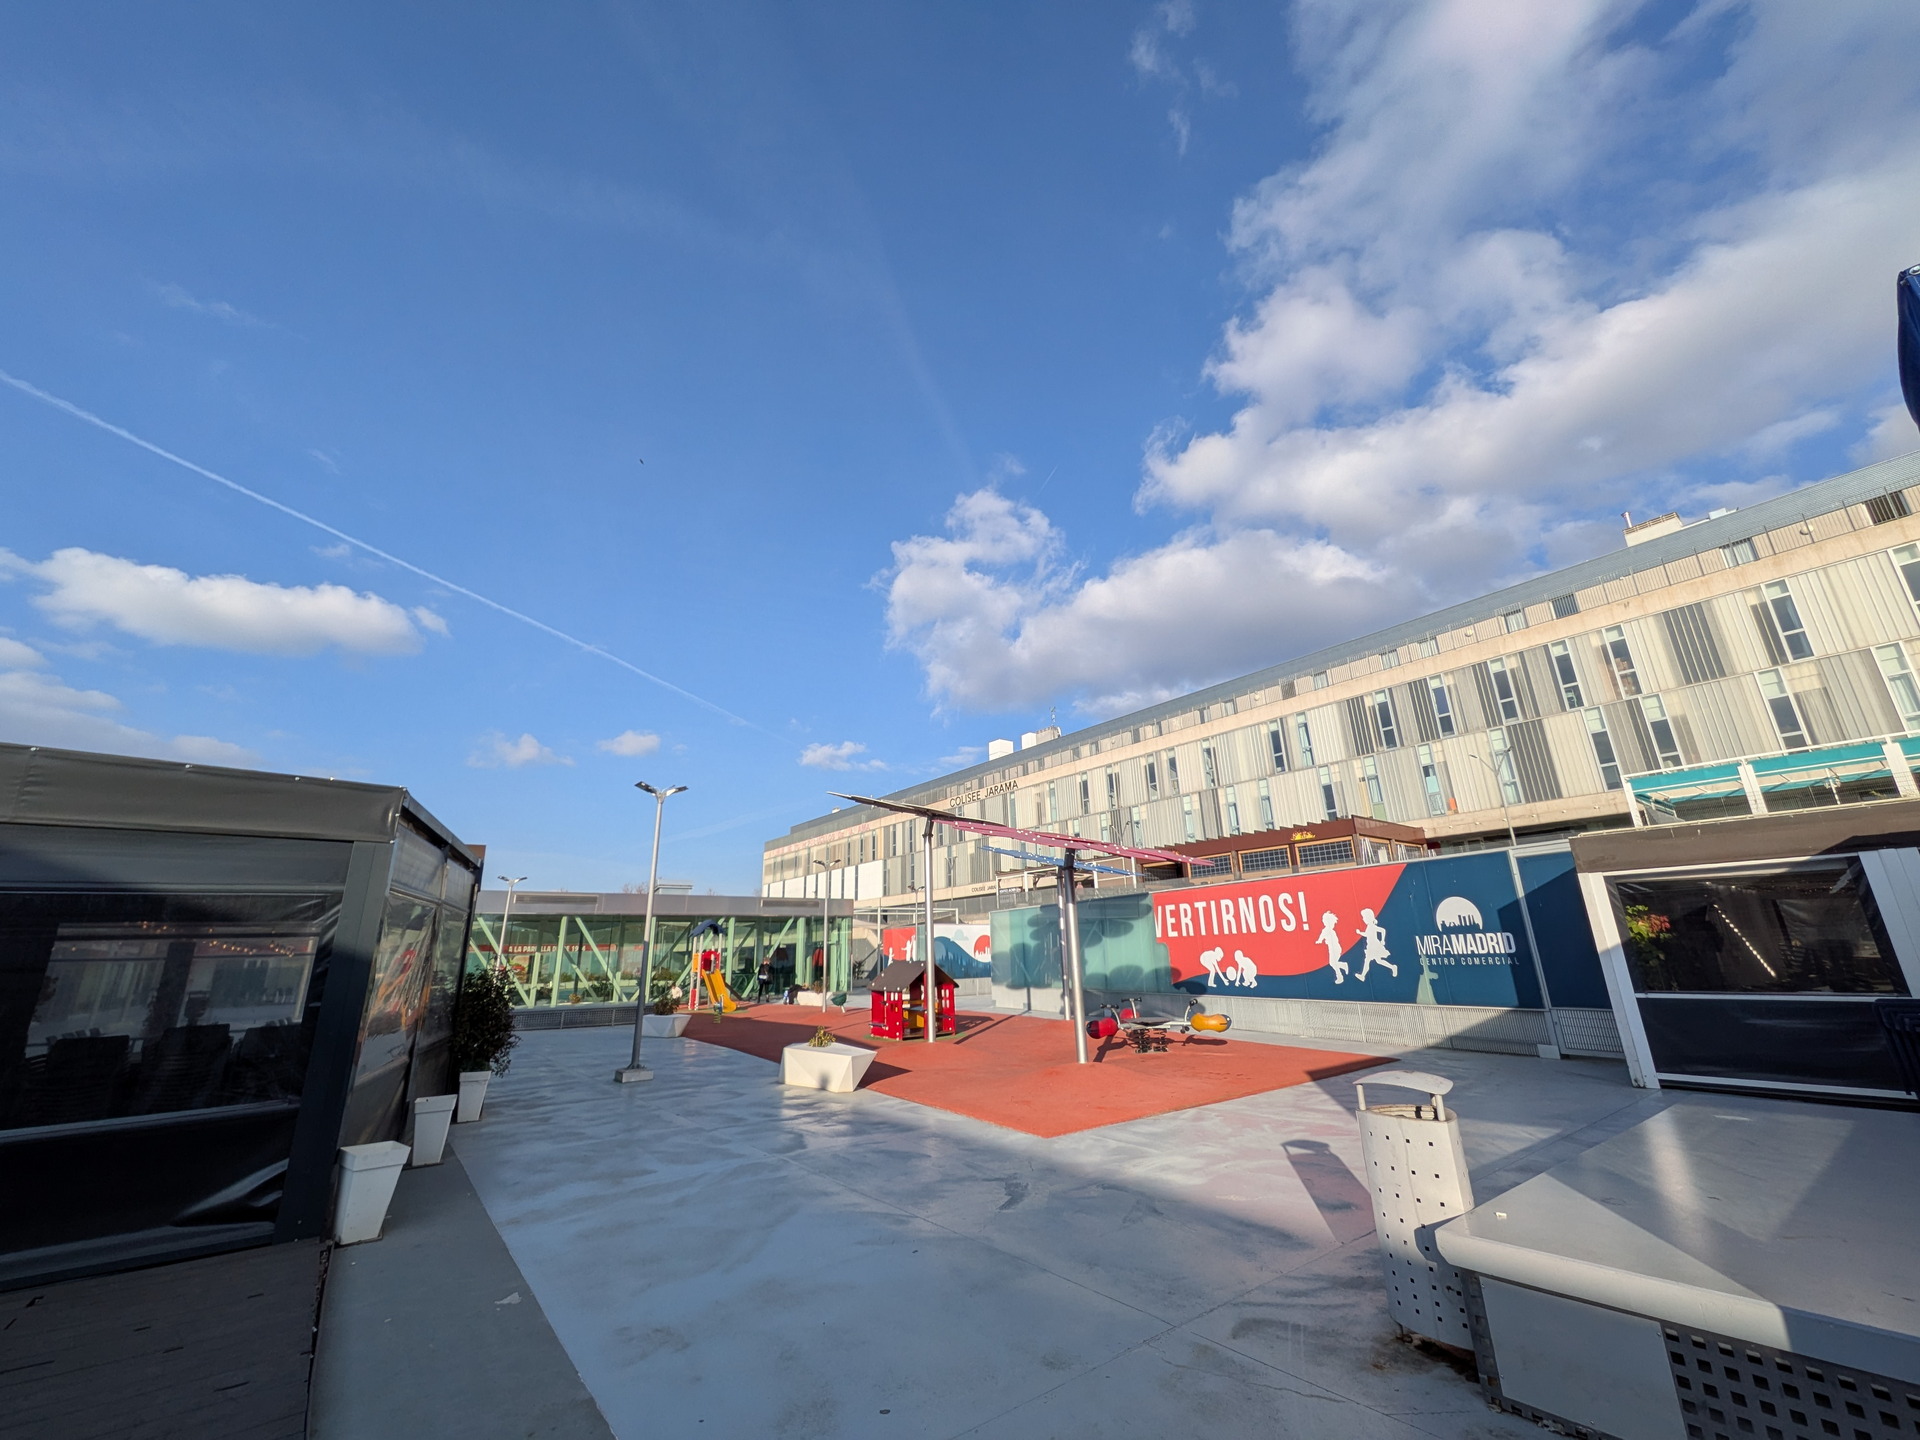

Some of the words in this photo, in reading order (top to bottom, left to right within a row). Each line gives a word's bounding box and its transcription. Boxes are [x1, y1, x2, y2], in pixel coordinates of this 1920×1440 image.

[949, 790, 981, 807] COLISEE
[984, 780, 1019, 798] JARAMA
[1415, 931, 1517, 956] MIRAMADRID
[1420, 957, 1456, 966] CENTRO
[1461, 956, 1520, 966] COMERCIAL
